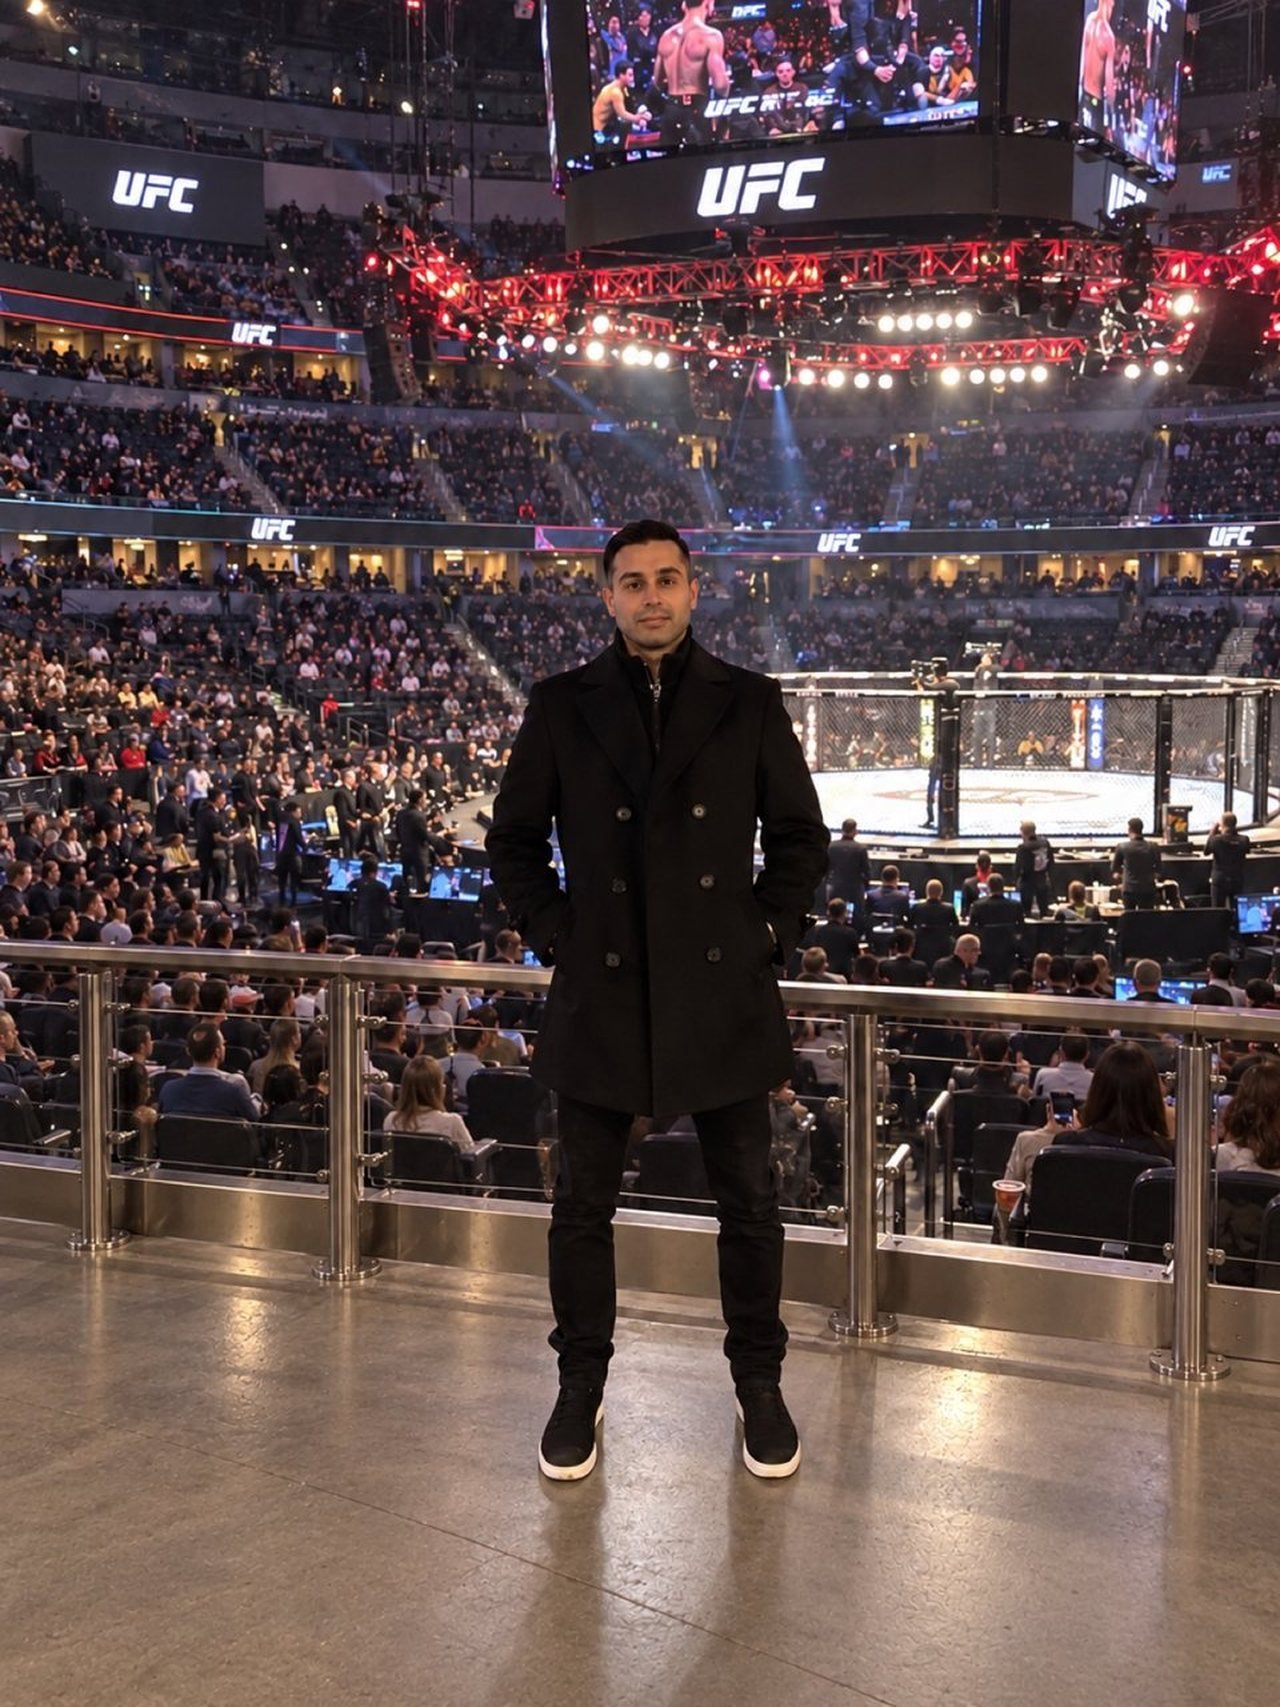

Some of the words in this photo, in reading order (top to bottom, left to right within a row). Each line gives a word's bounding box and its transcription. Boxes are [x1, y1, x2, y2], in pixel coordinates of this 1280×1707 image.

[704, 95, 759, 118] UFC
[1202, 164, 1231, 182] UFC
[112, 169, 199, 213] UFC
[697, 157, 825, 217] UFC
[231, 322, 277, 346] UFC
[251, 517, 296, 540] UFC
[1208, 526, 1255, 546] UFC
[817, 533, 861, 552] UFC
